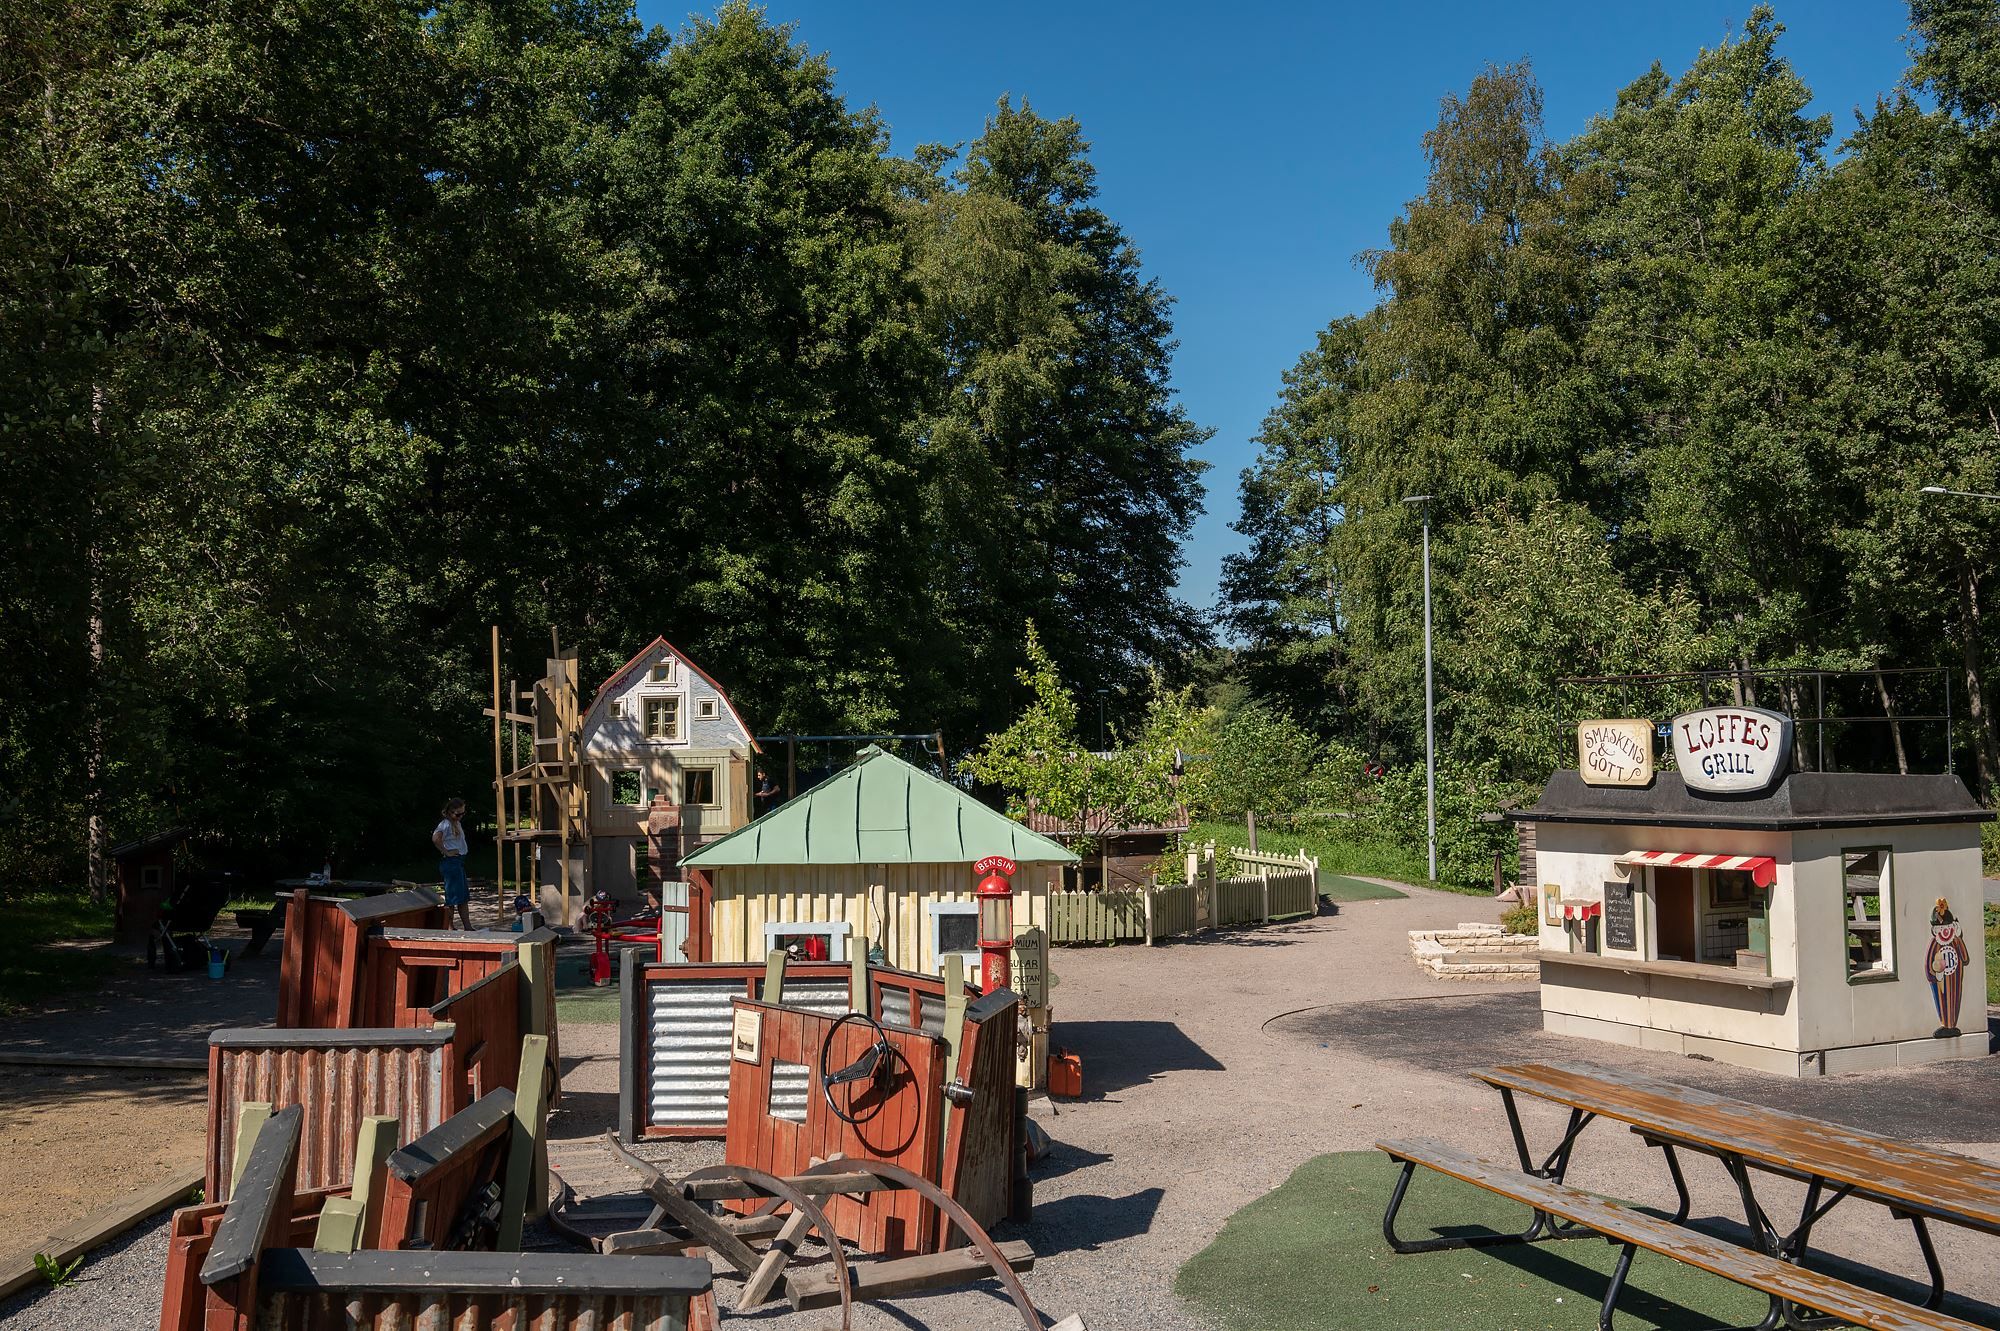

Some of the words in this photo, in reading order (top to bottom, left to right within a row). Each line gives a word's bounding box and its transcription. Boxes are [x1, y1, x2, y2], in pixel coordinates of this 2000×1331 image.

[1682, 715, 1771, 753] LOFFES
[1584, 727, 1645, 764] SMASKENS
[1597, 742, 1616, 757] &
[1702, 753, 1755, 779] GRILL
[977, 858, 1014, 871] BENSIN
[1013, 974, 1040, 983] OKTAN
